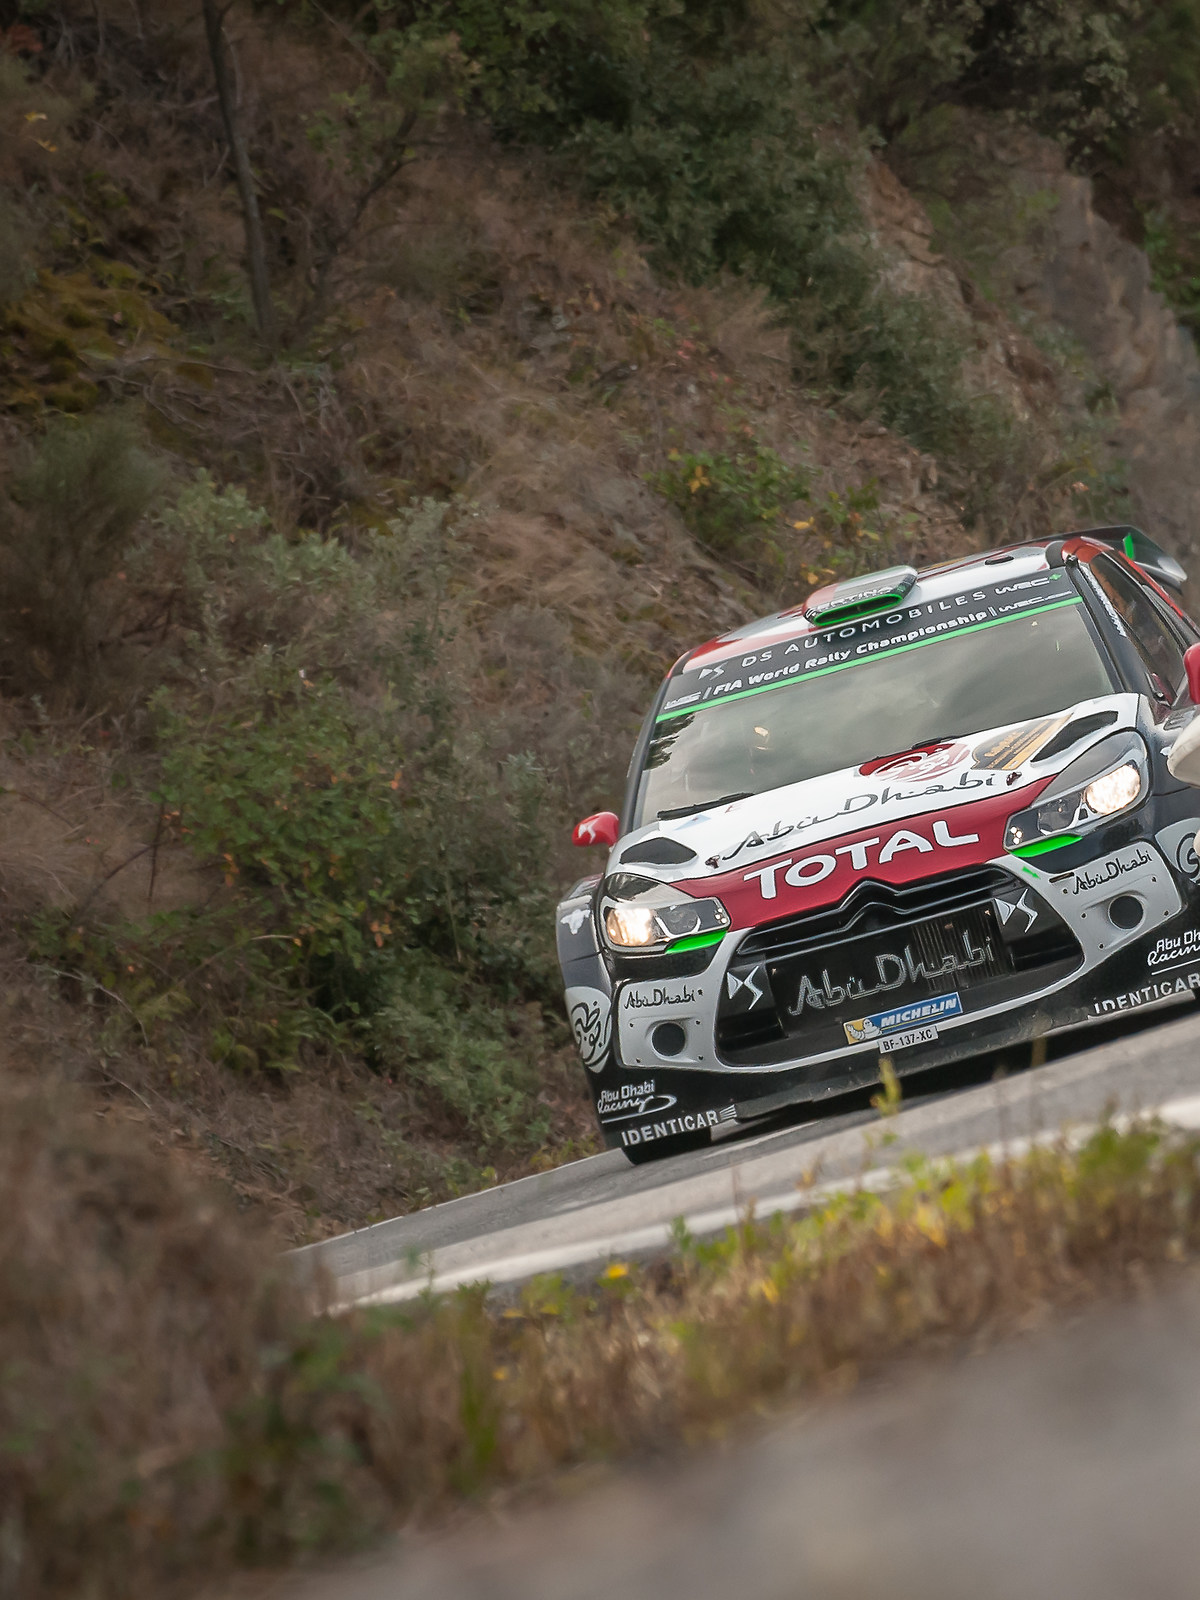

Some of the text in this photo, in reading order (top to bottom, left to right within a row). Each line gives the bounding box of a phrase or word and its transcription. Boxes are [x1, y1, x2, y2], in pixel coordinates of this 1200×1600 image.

[741, 651, 773, 668] DS
[784, 591, 986, 655] AUTOMOBILES
[713, 679, 742, 696] FIA
[749, 663, 800, 685] World
[804, 648, 851, 669] Rally
[856, 610, 988, 655] Championship
[722, 771, 996, 860] Abu Dhabi
[743, 820, 980, 900] TOTAL
[1073, 871, 1105, 895] Abu
[1105, 849, 1153, 880] Dhabi
[875, 928, 994, 992] Dhabi
[1156, 935, 1181, 954] Abu
[624, 985, 696, 1009] Abu Dhabi
[880, 997, 958, 1027] MICHELIN
[882, 1029, 933, 1051] BF-137-XC
[601, 1079, 656, 1103] Abu Dhabi
[620, 1110, 719, 1147] IDENTICAR
